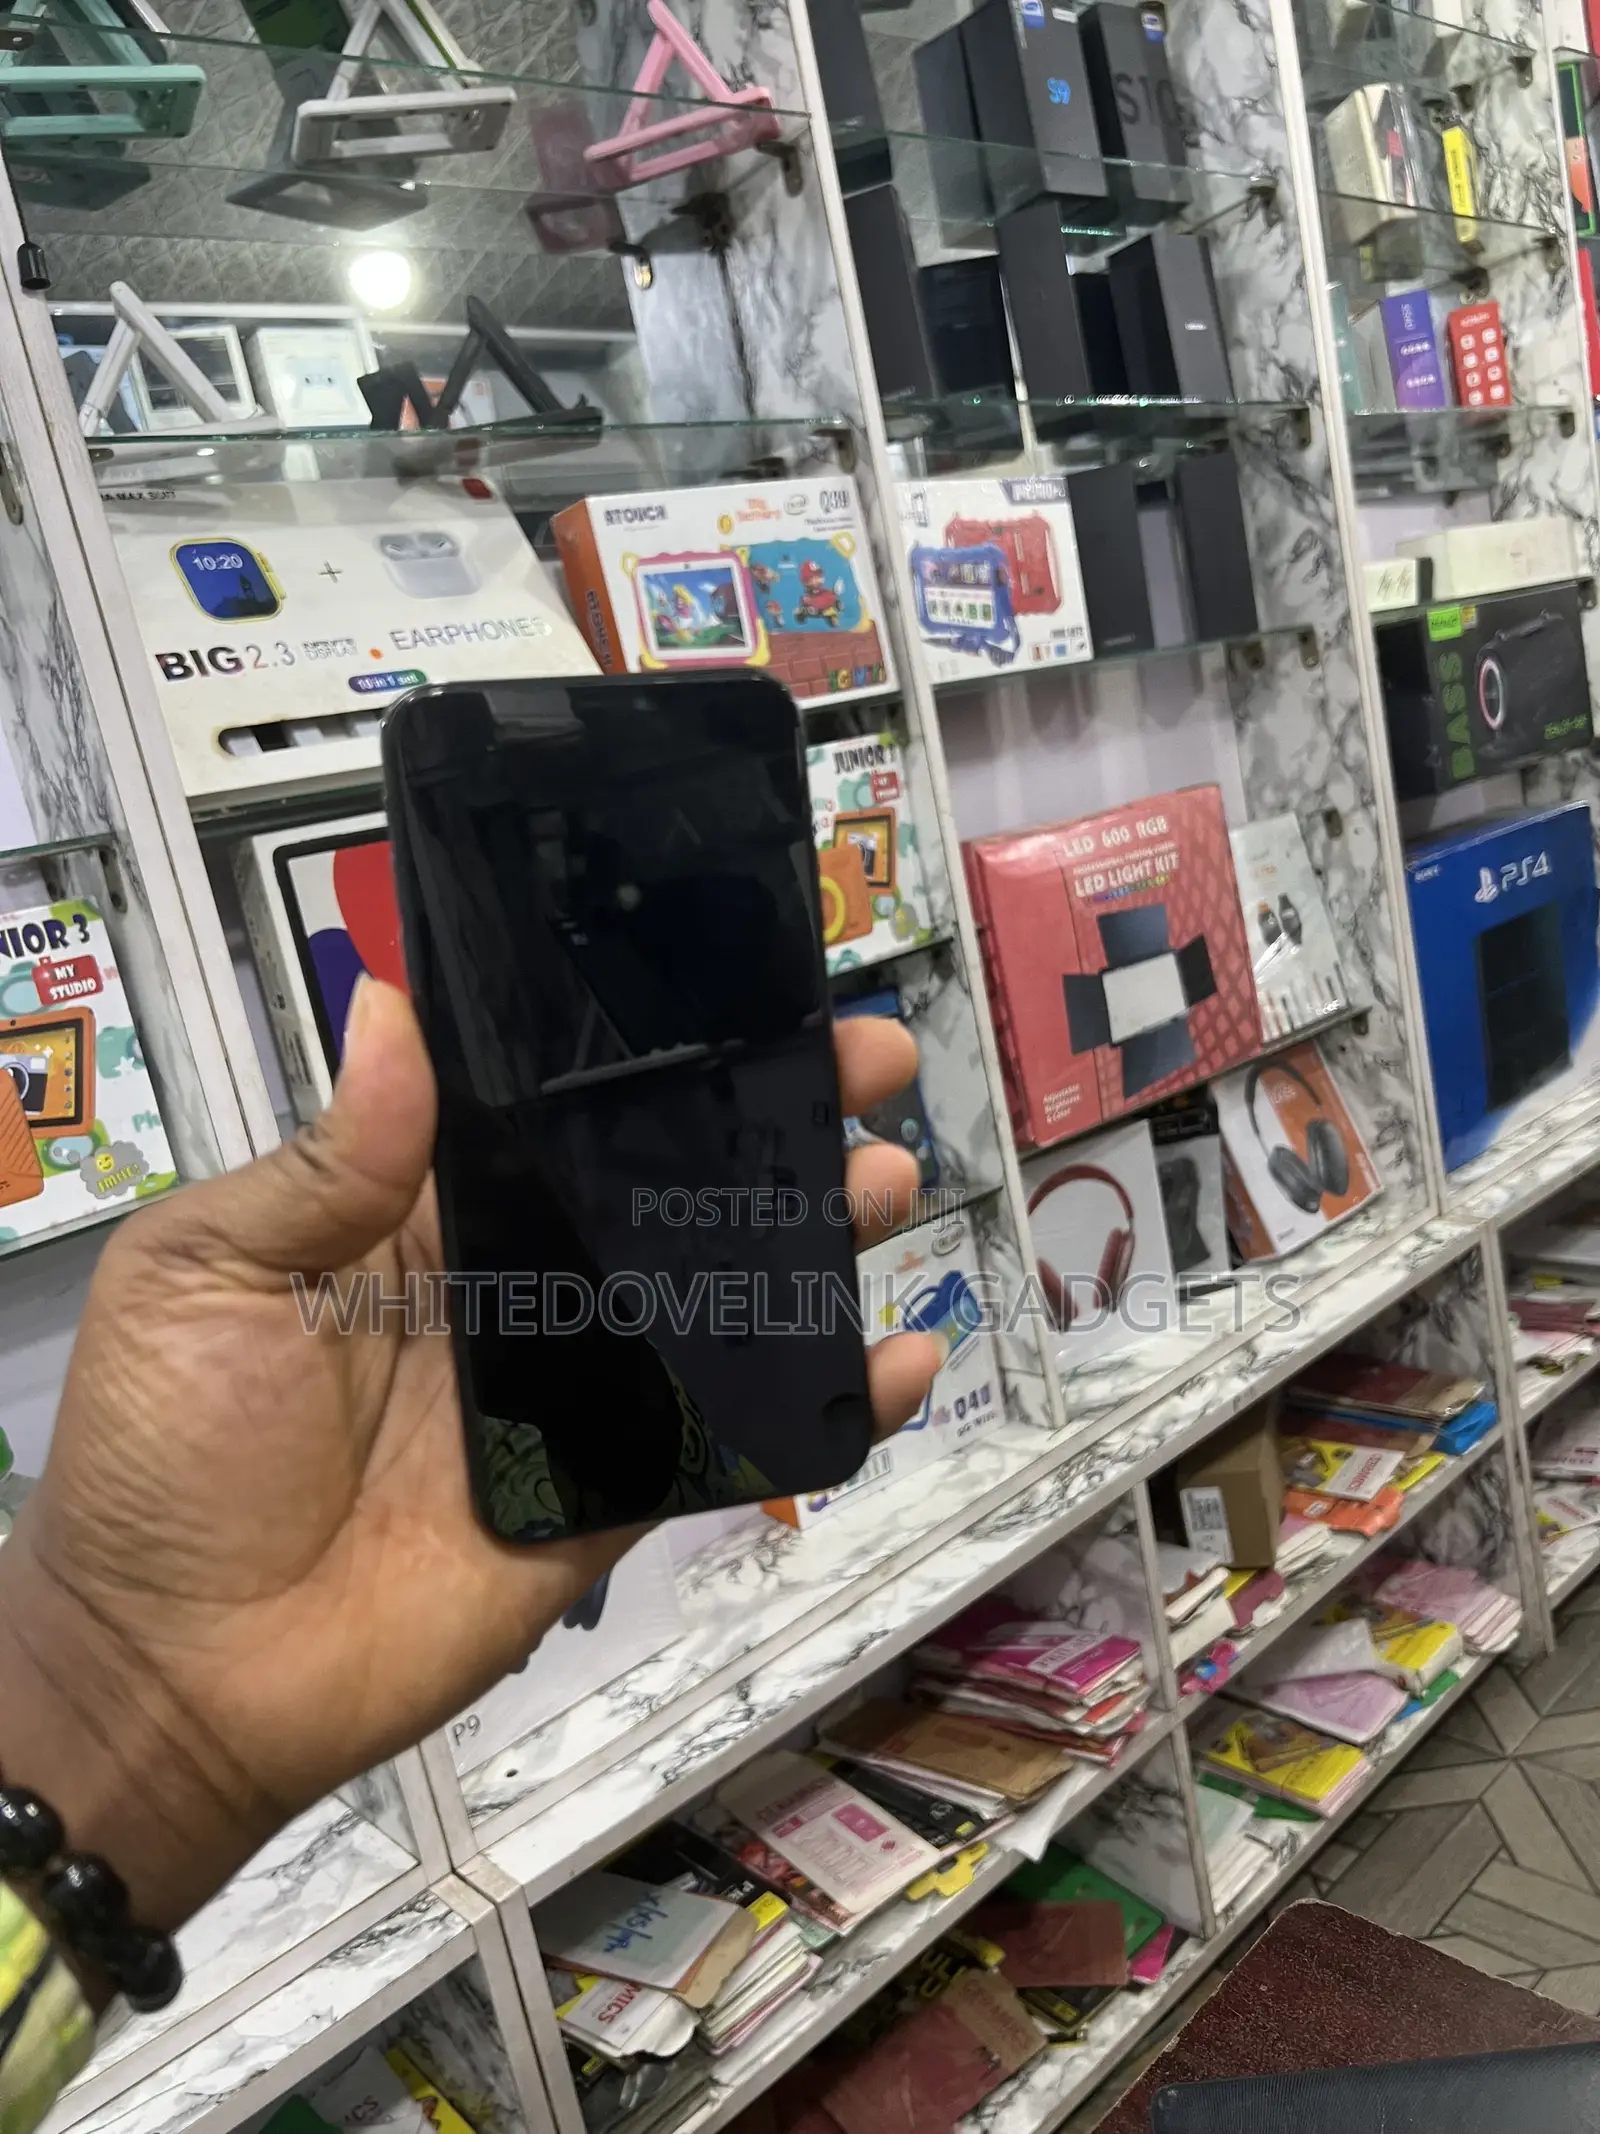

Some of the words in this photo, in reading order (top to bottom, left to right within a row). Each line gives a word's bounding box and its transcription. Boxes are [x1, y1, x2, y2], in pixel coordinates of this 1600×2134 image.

[1047, 77, 1071, 104] S9
[193, 553, 243, 571] 10:20
[155, 646, 245, 682] BIG
[246, 640, 296, 670] 2.3
[389, 616, 552, 651] EARPHONES
[832, 744, 884, 775] JUNIOR
[1062, 835, 1096, 858] LED
[1101, 824, 1132, 849] 600
[1135, 815, 1170, 839] RGB
[1074, 874, 1105, 898] LED
[1107, 859, 1153, 888] LIGHT
[1154, 851, 1180, 873] KIT
[1500, 850, 1551, 892] PS4
[72, 912, 91, 944] 3
[53, 963, 78, 982] MY
[50, 977, 97, 1001] STUDIO
[452, 1714, 481, 1747] P9
